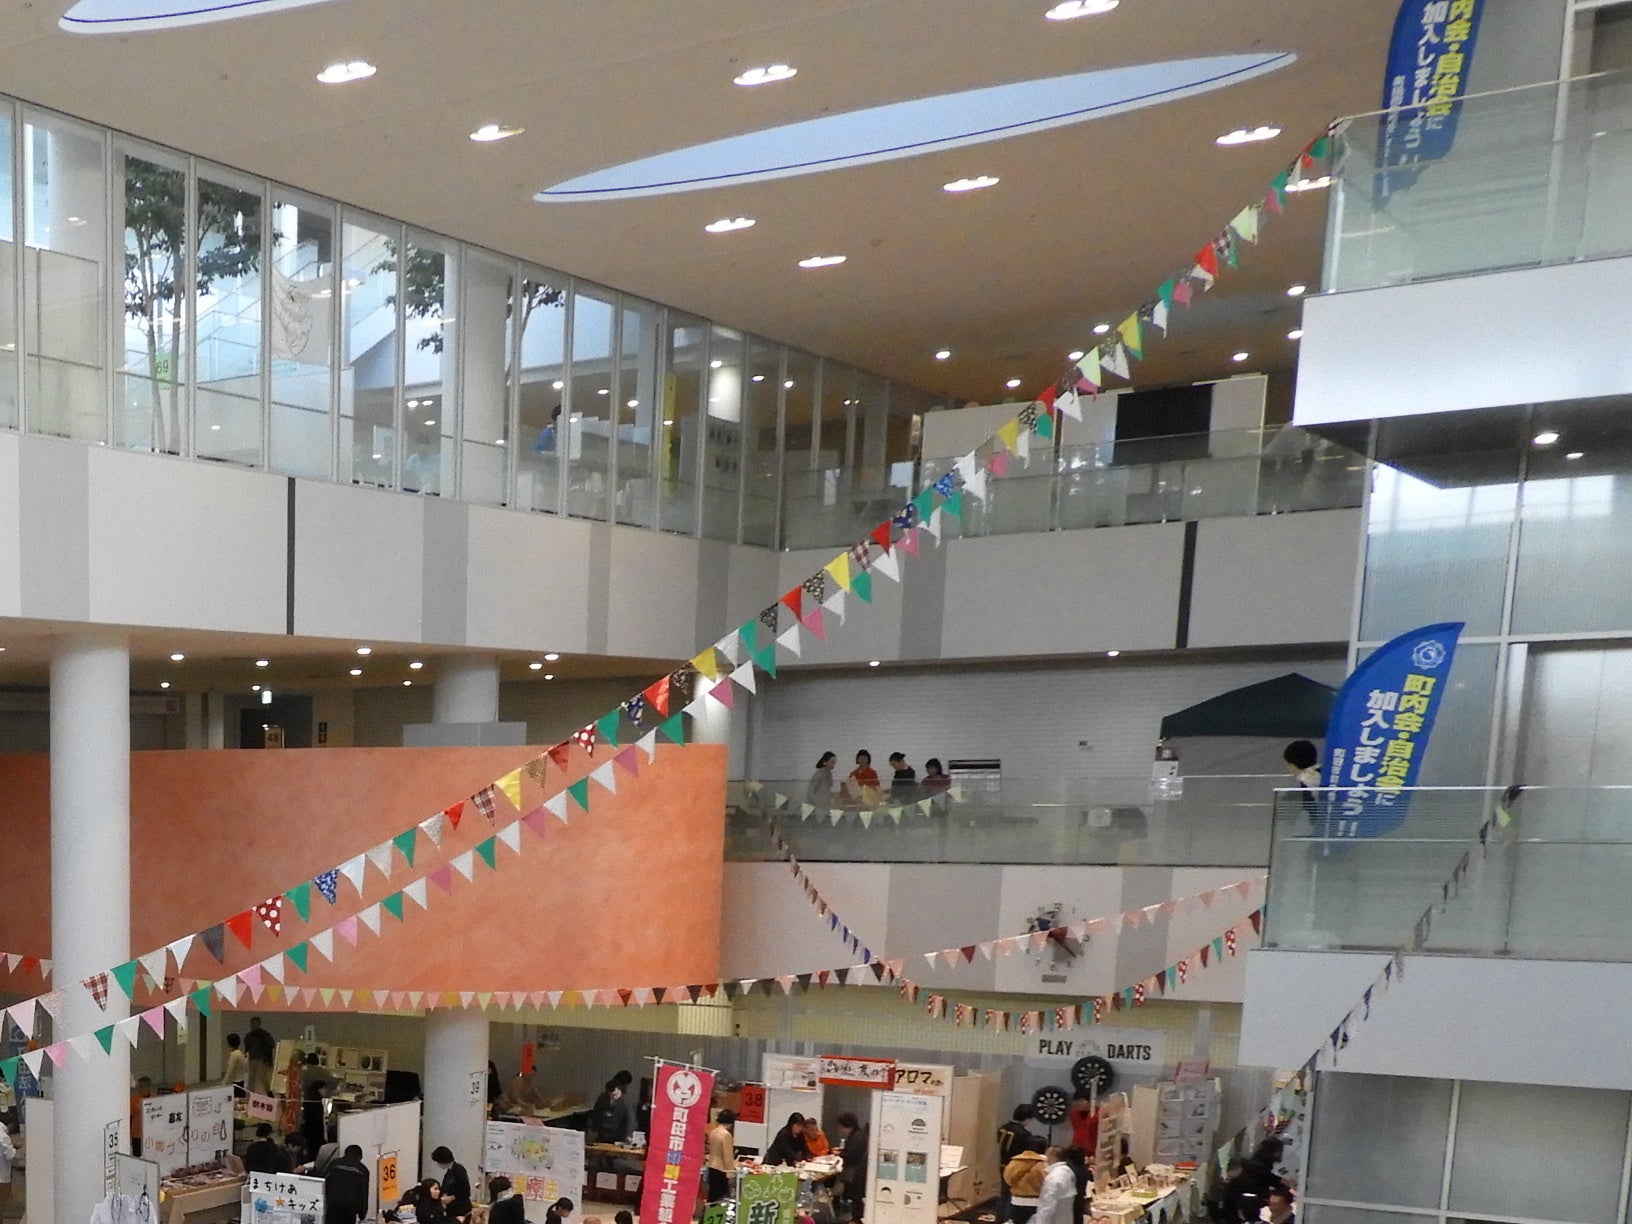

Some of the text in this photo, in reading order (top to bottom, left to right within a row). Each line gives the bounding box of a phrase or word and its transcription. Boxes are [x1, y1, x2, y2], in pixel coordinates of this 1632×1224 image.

[1375, 674, 1437, 806] 町内会・自治会に
[1039, 1039, 1152, 1061] PLAY DARTS
[744, 1092, 764, 1108] 38
[383, 1163, 397, 1182] 36
[253, 1178, 298, 1196] まちけあ
[288, 1198, 320, 1212] キッズ
